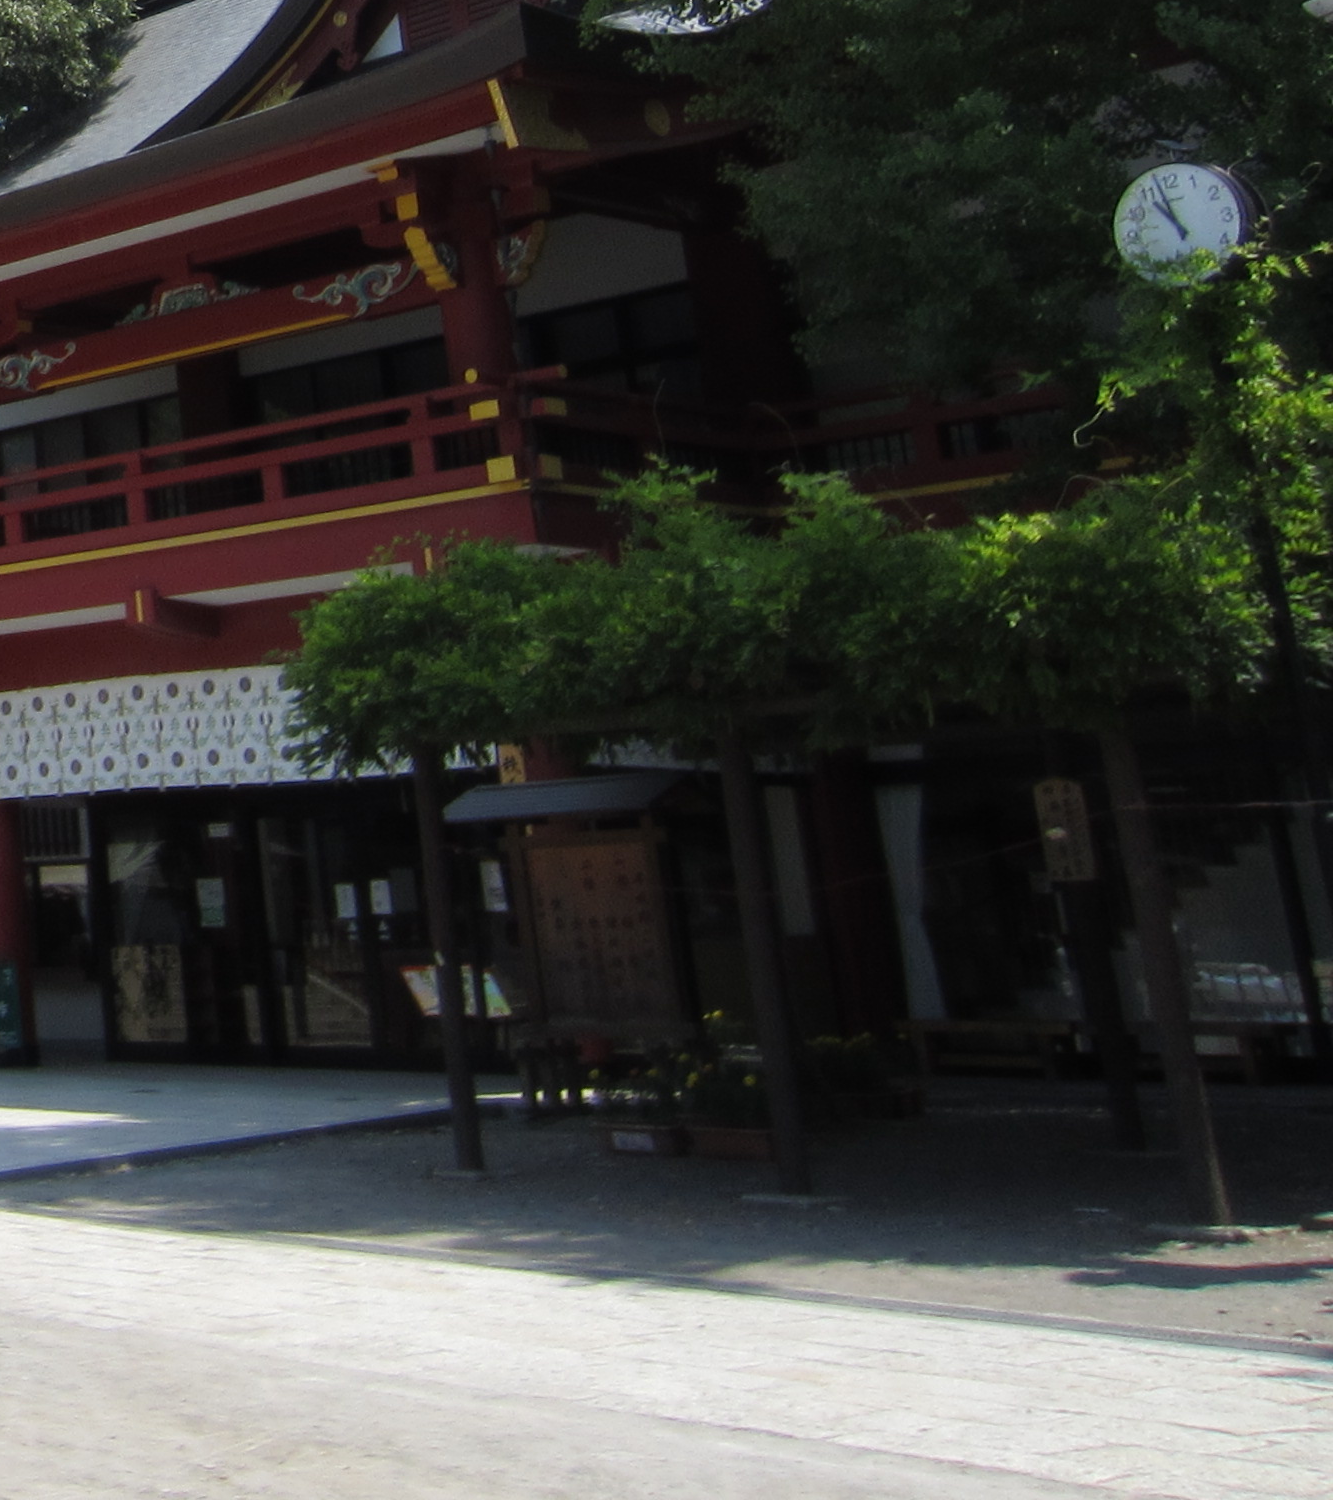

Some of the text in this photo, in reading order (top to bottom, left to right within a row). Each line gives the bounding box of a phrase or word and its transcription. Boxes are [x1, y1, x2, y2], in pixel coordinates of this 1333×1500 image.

[1162, 173, 1179, 189] 12
[1188, 174, 1197, 189] 1
[1140, 187, 1156, 202] 11
[1208, 185, 1220, 201] 2
[1220, 206, 1234, 223] 3
